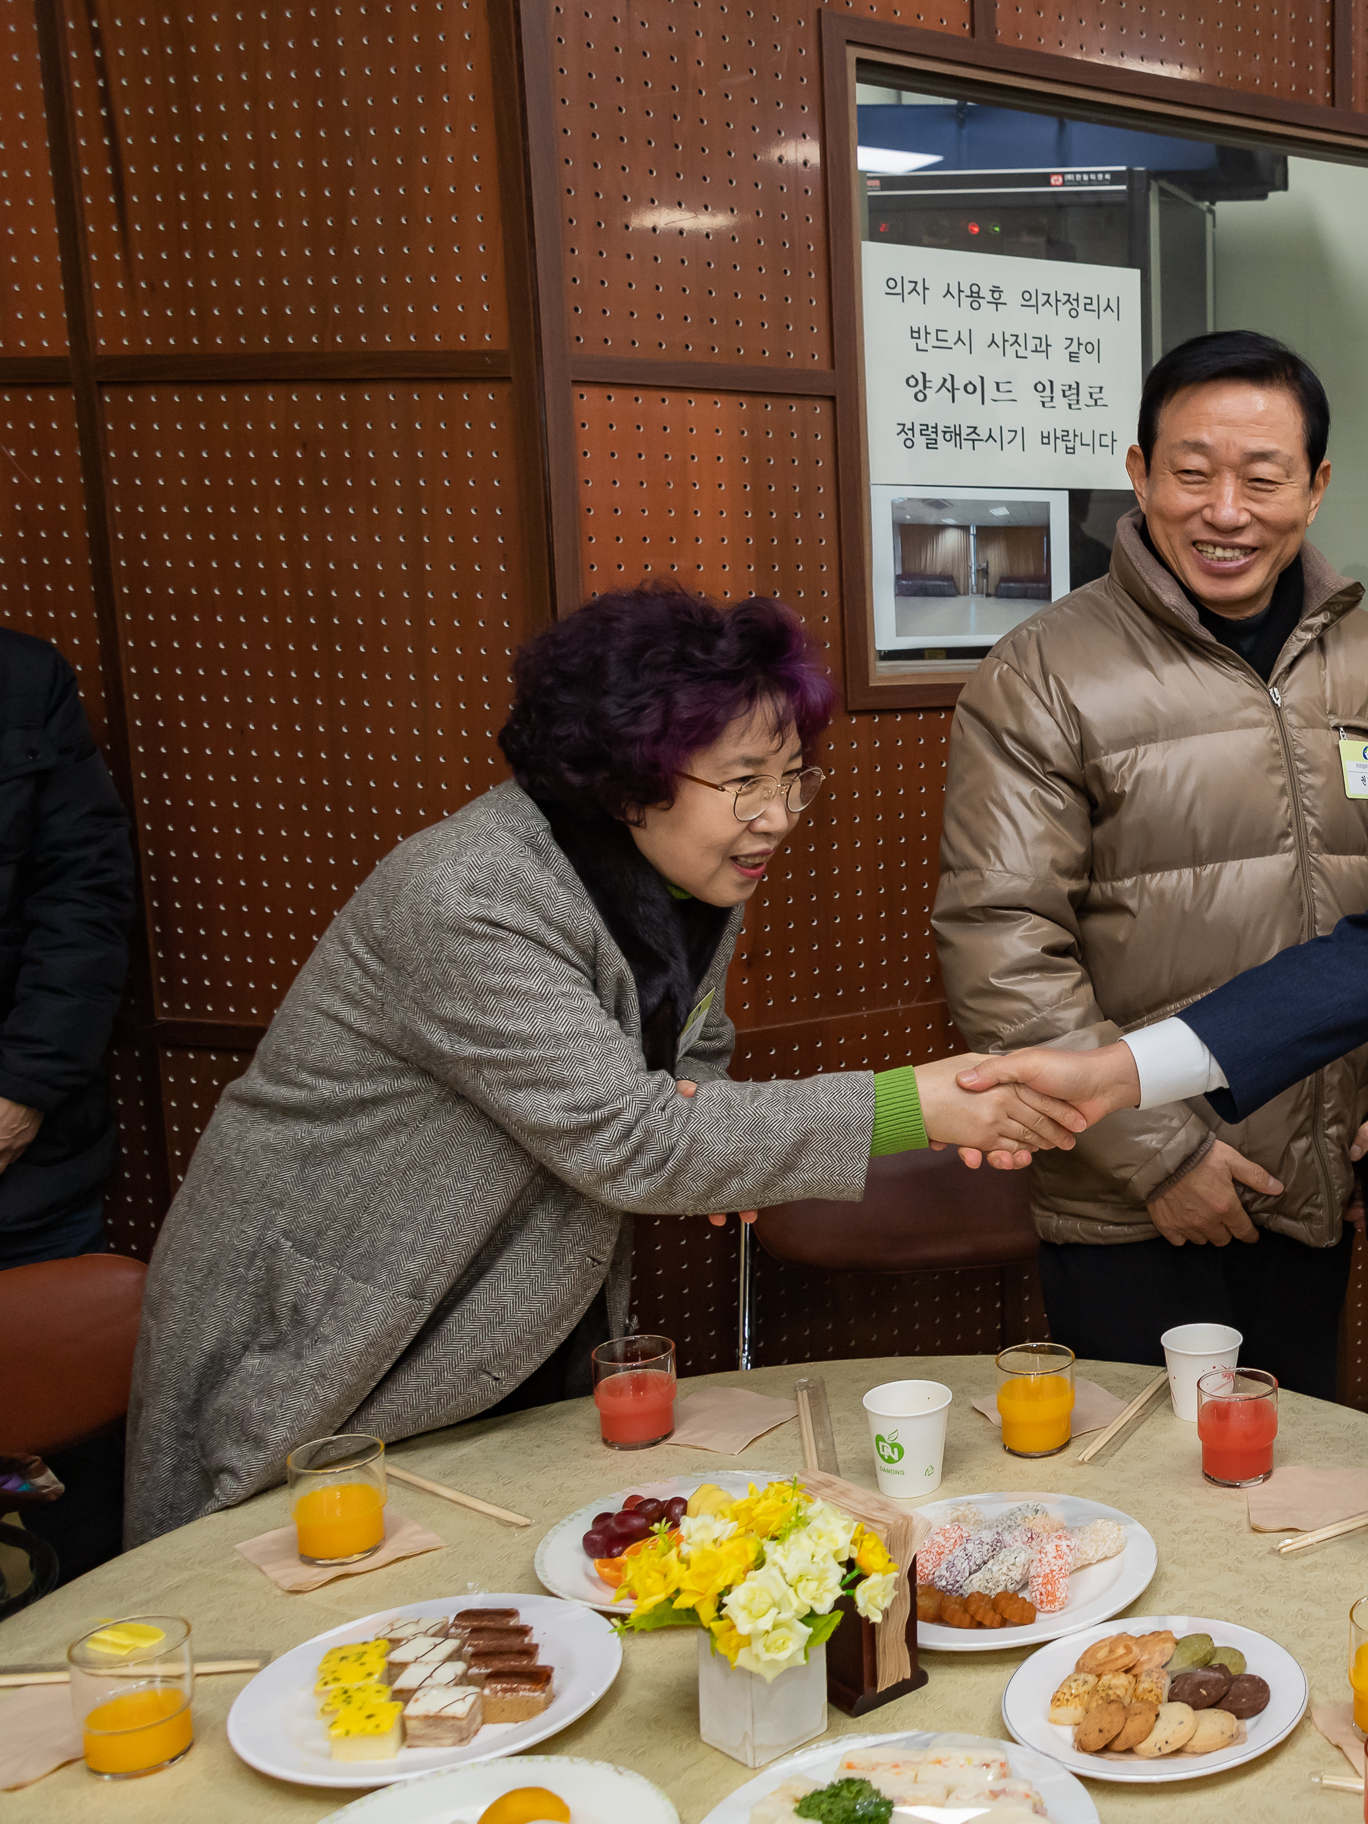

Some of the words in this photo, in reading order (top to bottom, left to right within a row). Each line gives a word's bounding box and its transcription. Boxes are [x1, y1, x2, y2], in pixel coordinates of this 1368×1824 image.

[884, 275, 930, 305] 의자
[942, 281, 1008, 312] 사용후
[1020, 288, 1120, 322] 의자정리시
[909, 324, 973, 355] 반드시
[987, 330, 1052, 360] 사진과
[1064, 336, 1101, 364] 같이
[905, 371, 1018, 406] 양사이드
[1033, 378, 1109, 411] 일렬로
[896, 421, 1025, 453] 정렬해주시기
[1040, 427, 1118, 456] 바랍니다
